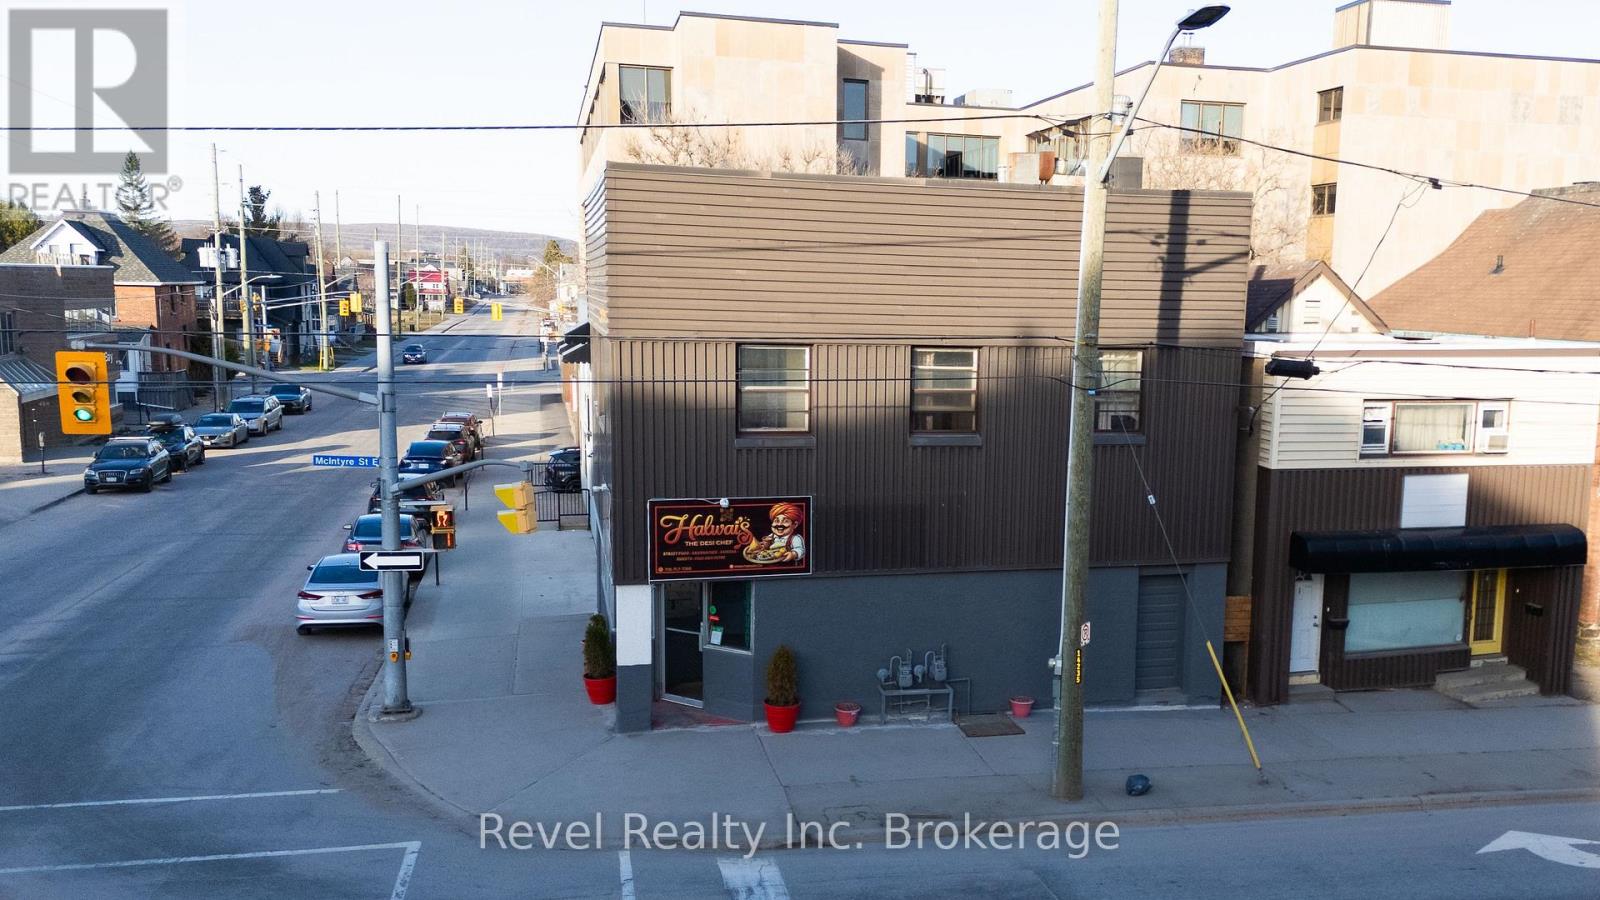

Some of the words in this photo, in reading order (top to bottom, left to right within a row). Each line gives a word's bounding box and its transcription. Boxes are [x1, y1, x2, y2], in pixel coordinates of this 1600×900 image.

[315, 457, 354, 466] McIntyre
[358, 458, 369, 466] St
[372, 458, 379, 466] E
